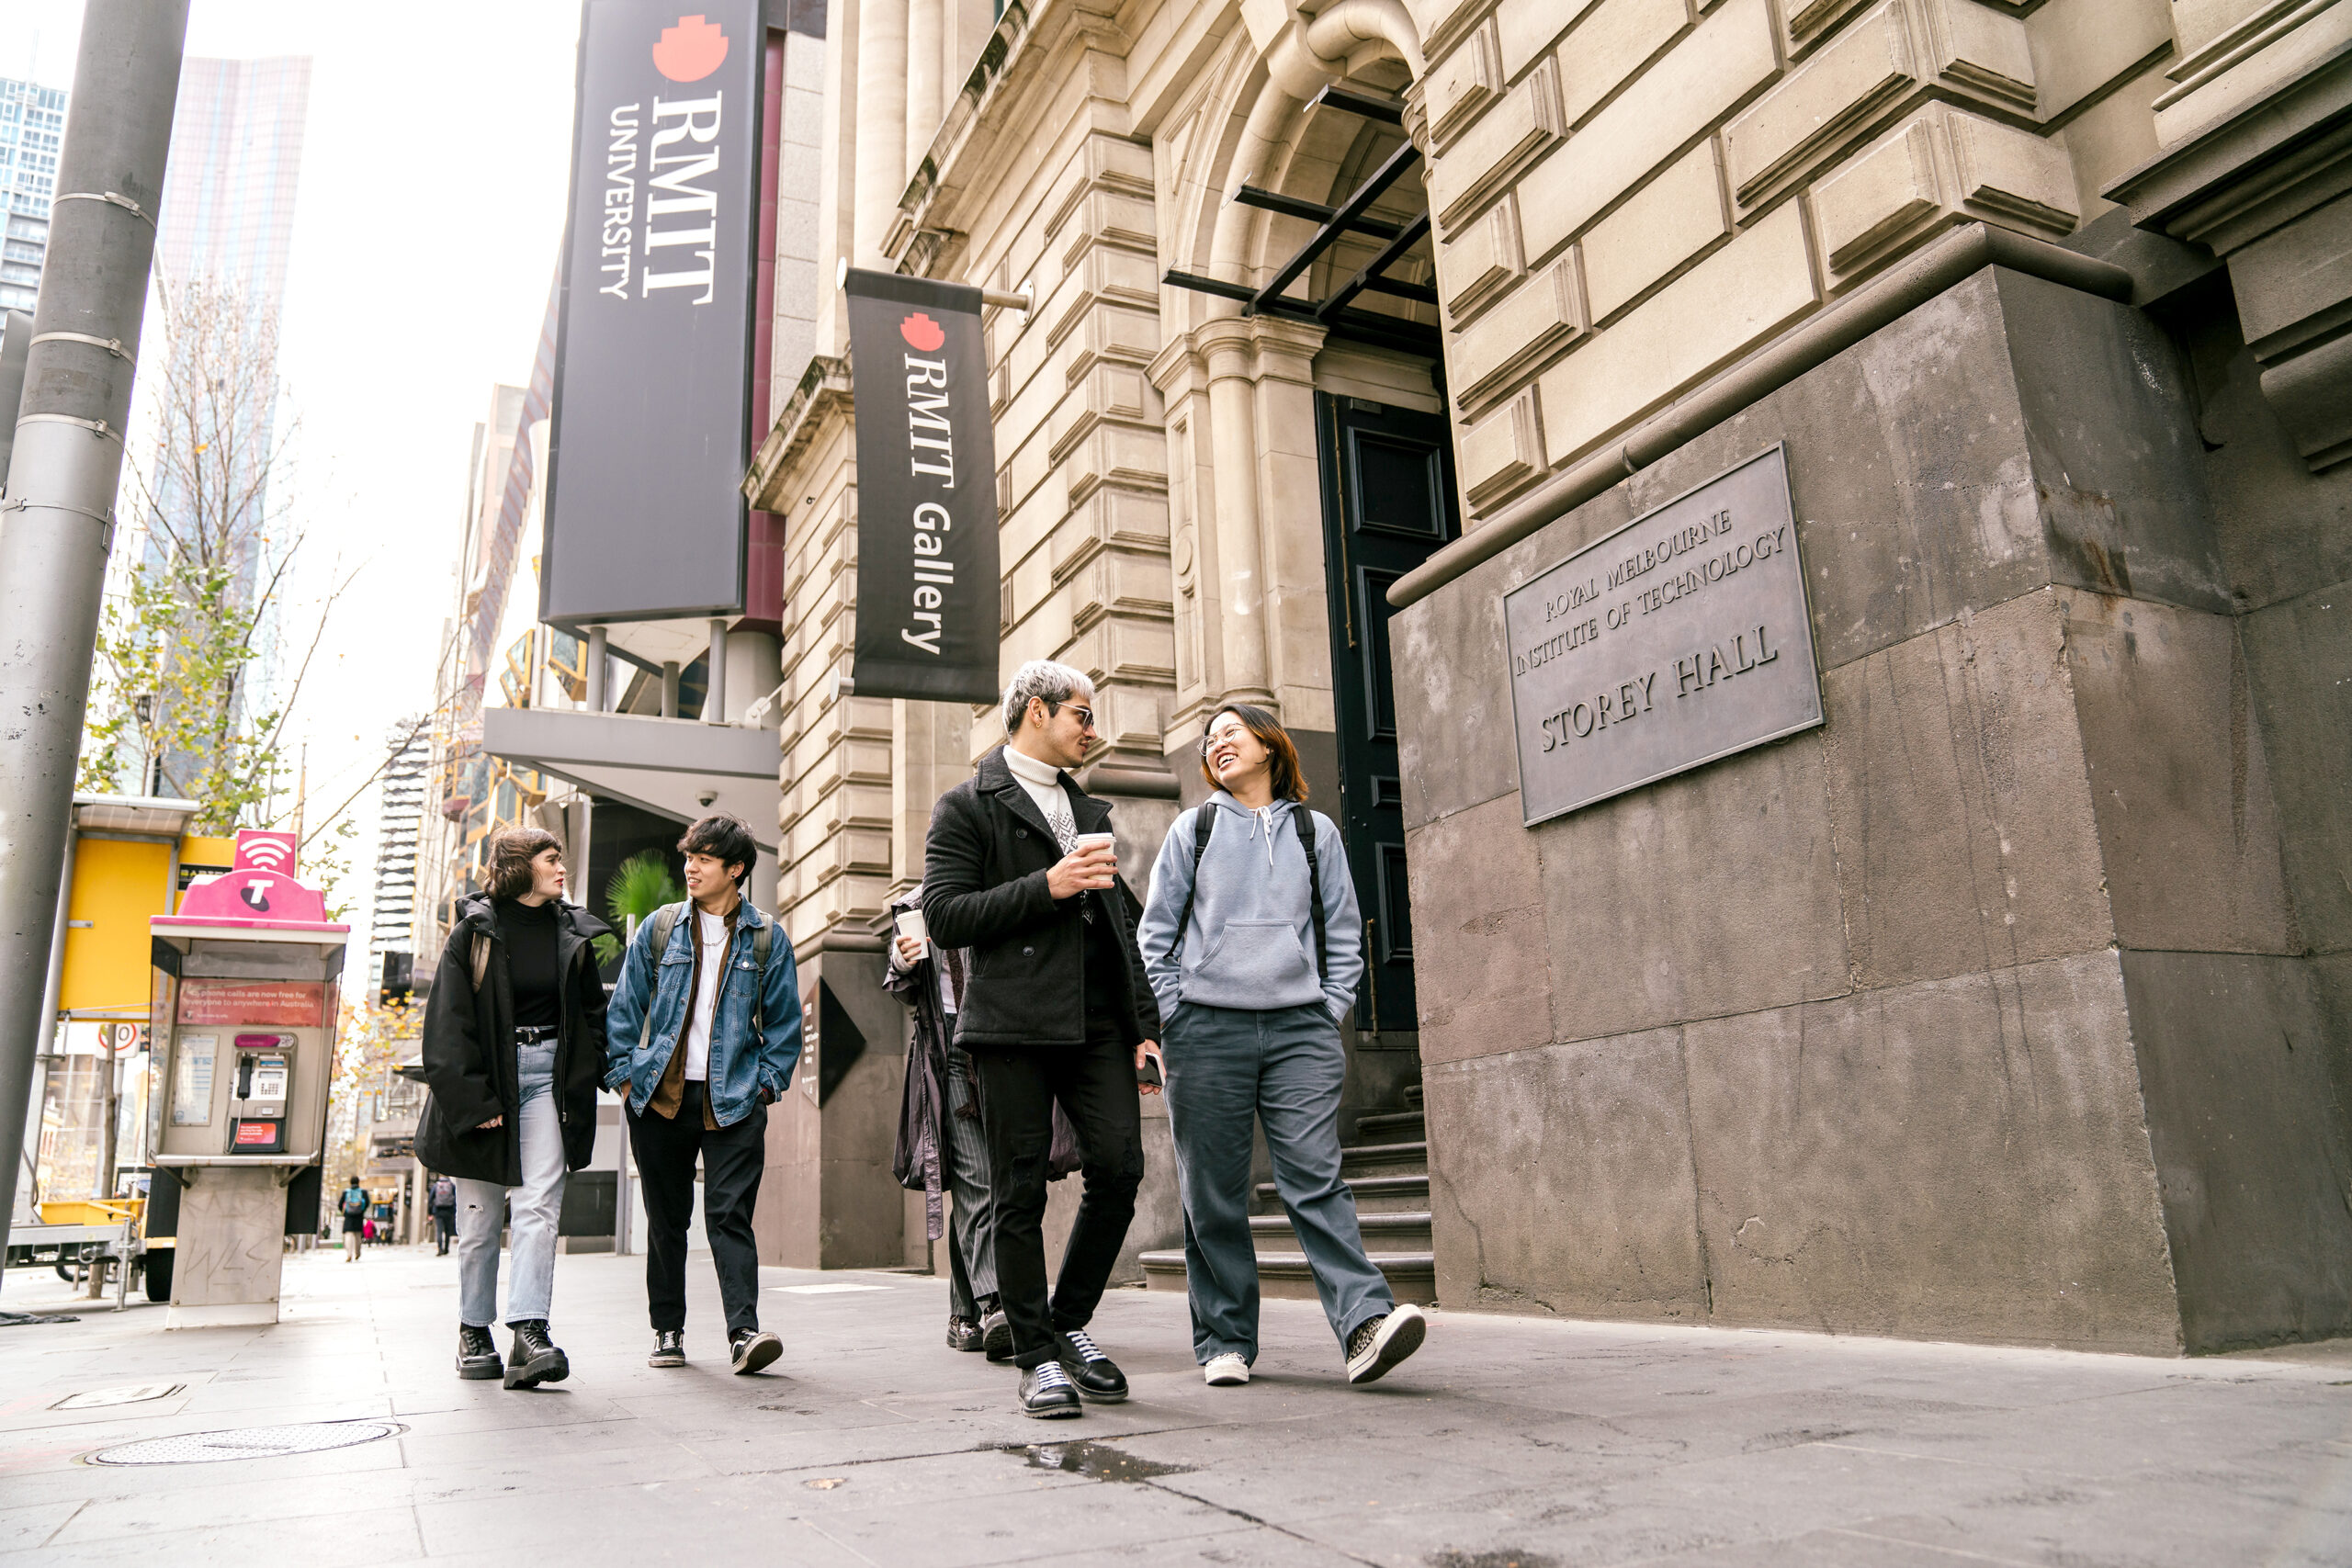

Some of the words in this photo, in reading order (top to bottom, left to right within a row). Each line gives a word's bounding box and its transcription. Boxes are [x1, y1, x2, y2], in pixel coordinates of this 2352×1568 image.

[599, 103, 639, 299] UNIVERSITY
[642, 90, 722, 305] RMIT
[904, 353, 955, 489] RMIT
[901, 502, 954, 655] Gallery
[1515, 617, 1599, 676] INSTITUTE
[1606, 602, 1631, 630] OF
[1637, 526, 1785, 616] TECHNOLOGY
[1544, 578, 1599, 623] ROYAL
[1607, 508, 1732, 591] MELBOURNE
[1542, 672, 1656, 753] STOREY
[1672, 626, 1778, 698] HALL
[247, 879, 274, 904] T
